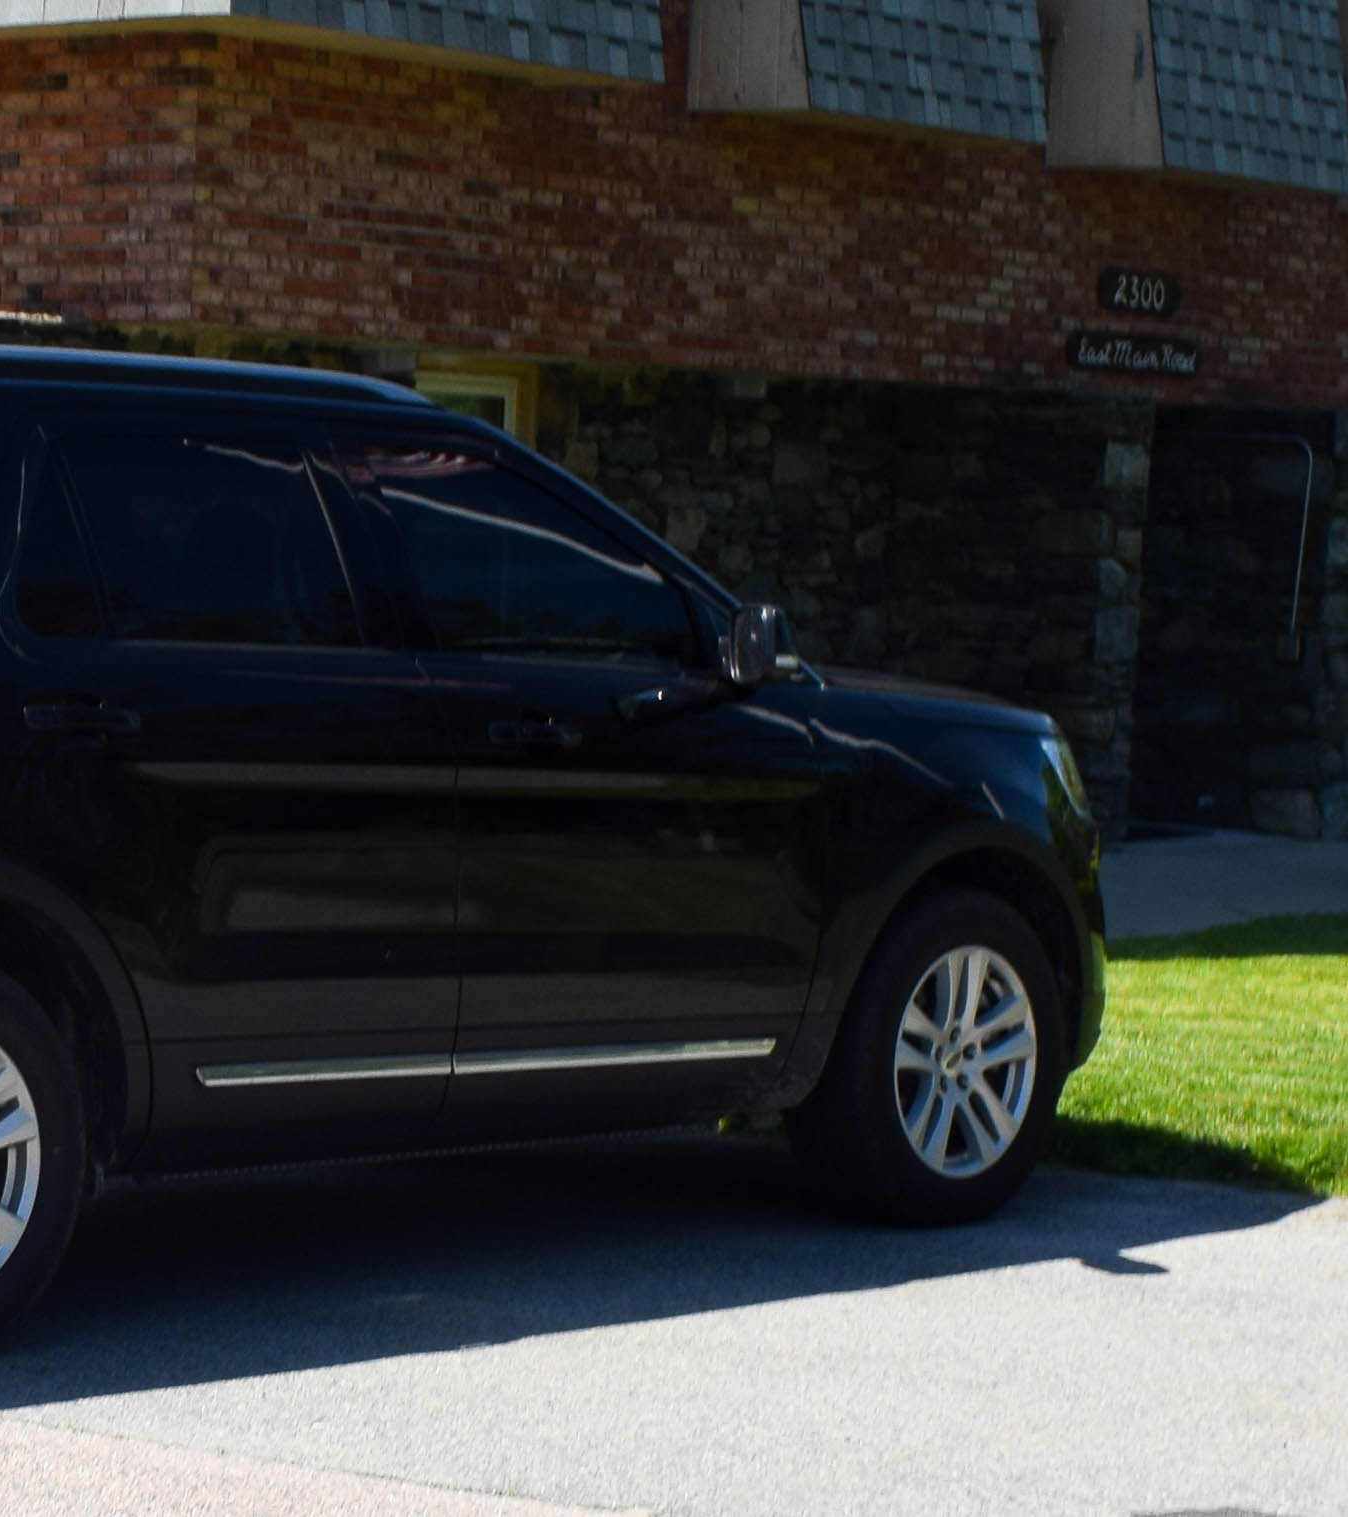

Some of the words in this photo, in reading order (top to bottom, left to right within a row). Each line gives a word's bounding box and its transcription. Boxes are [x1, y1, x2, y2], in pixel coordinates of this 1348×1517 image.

[1114, 273, 1165, 312] 2300
[1077, 336, 1112, 366] East
[1114, 338, 1159, 369] Main
[1160, 343, 1197, 375] Road
